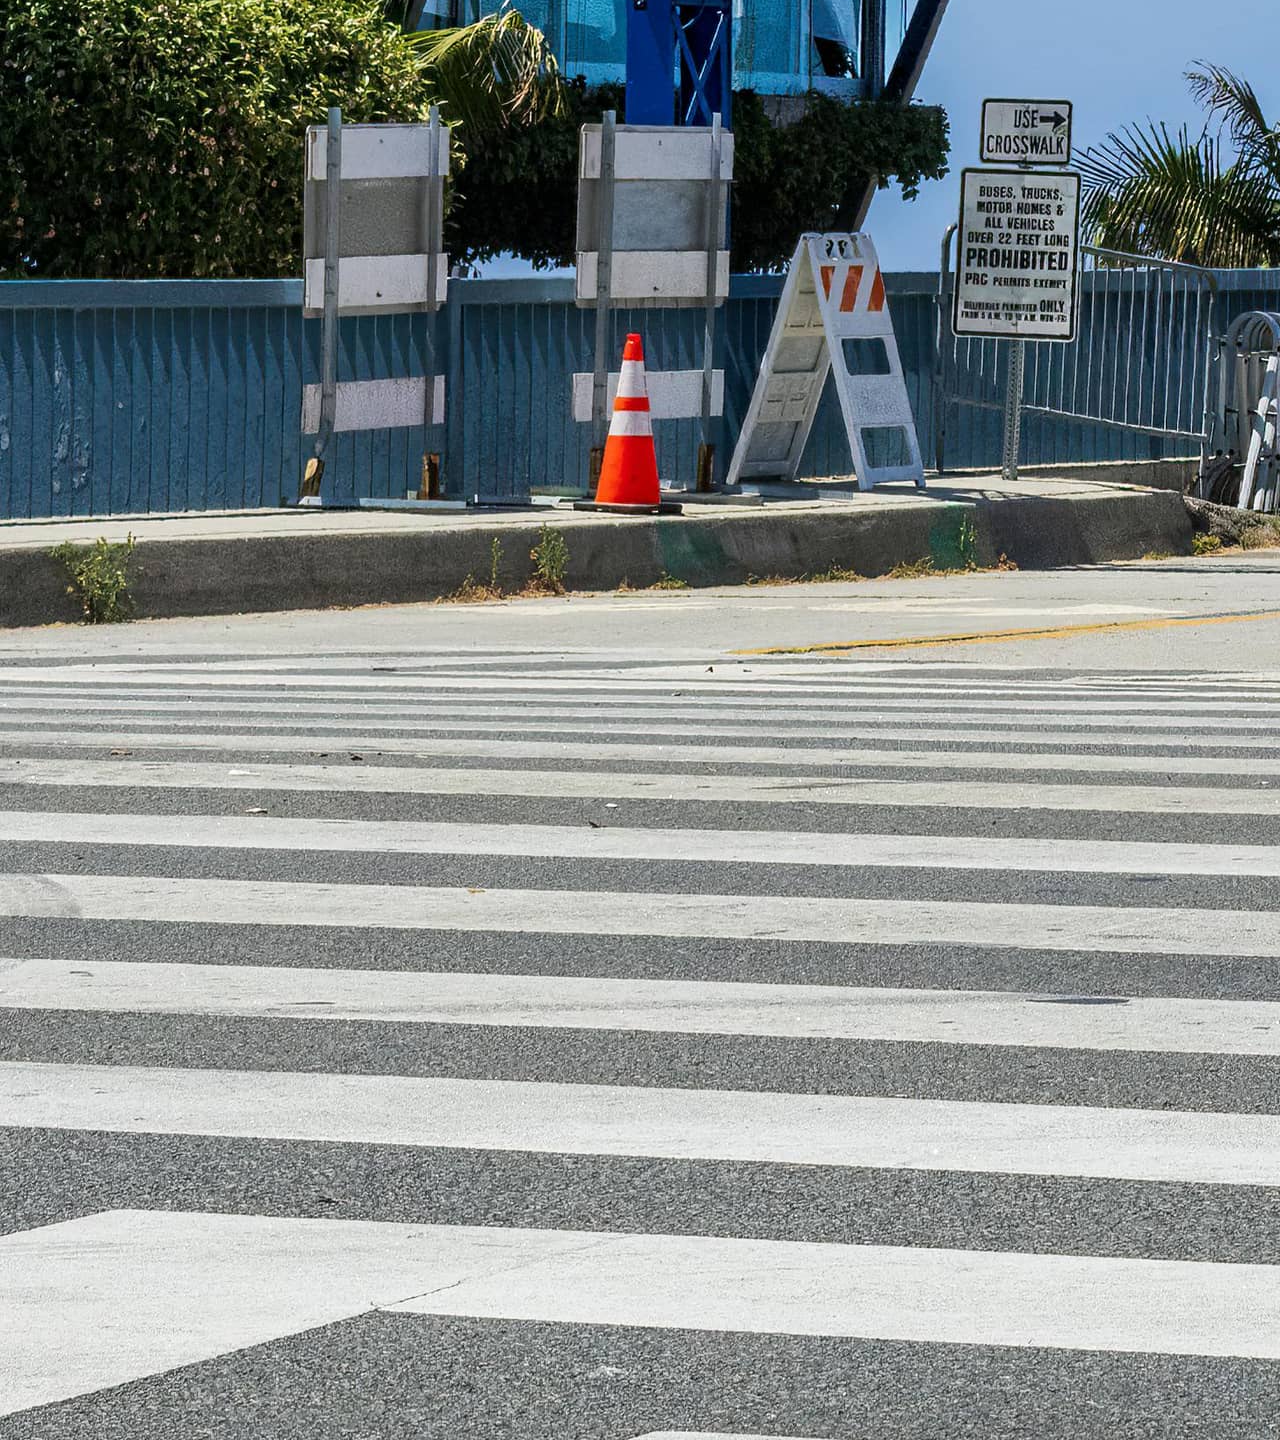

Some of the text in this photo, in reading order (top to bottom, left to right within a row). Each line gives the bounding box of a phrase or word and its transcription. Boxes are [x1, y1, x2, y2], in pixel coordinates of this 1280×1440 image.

[1014, 109, 1039, 128] USE
[986, 135, 1065, 155] CROSSWALK
[979, 185, 1016, 199] BUSES,
[976, 201, 1064, 216] MOTOR HOMES &
[984, 217, 1055, 231] ALL VEHICLES
[968, 232, 1070, 247] OVER 22 FEET LONG
[966, 247, 1069, 271] PROHIBITED
[965, 272, 1067, 289] PRC PERMITS EXEMPT
[1040, 299, 1065, 313] ONLY
